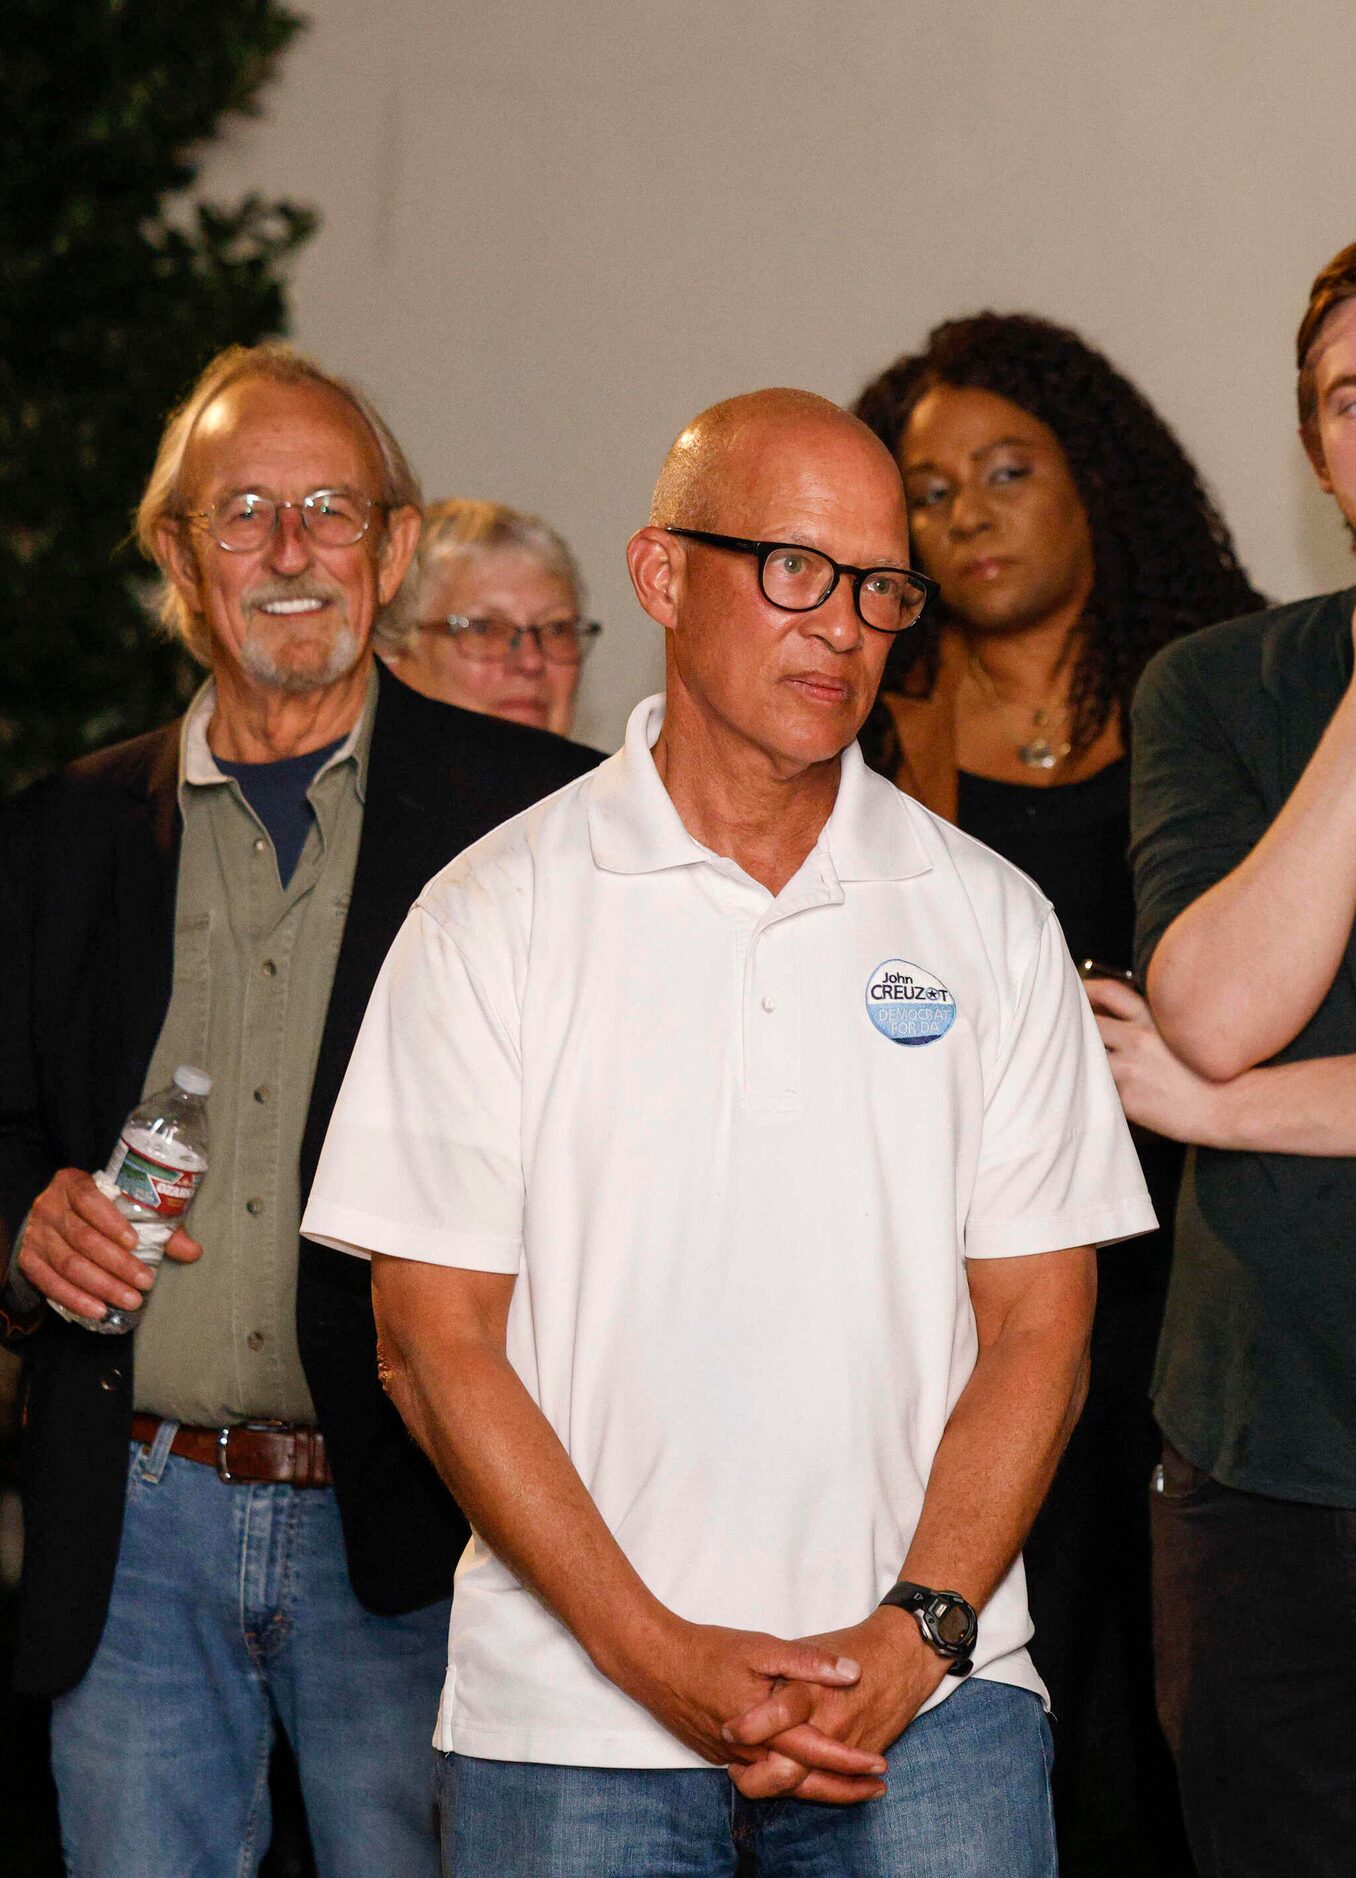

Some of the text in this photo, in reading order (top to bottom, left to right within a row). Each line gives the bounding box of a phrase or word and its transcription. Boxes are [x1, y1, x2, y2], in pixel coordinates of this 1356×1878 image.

[882, 972, 913, 984] John
[879, 1008, 950, 1021] DEMOCRAT
[891, 1021, 939, 1035] FOR DA
